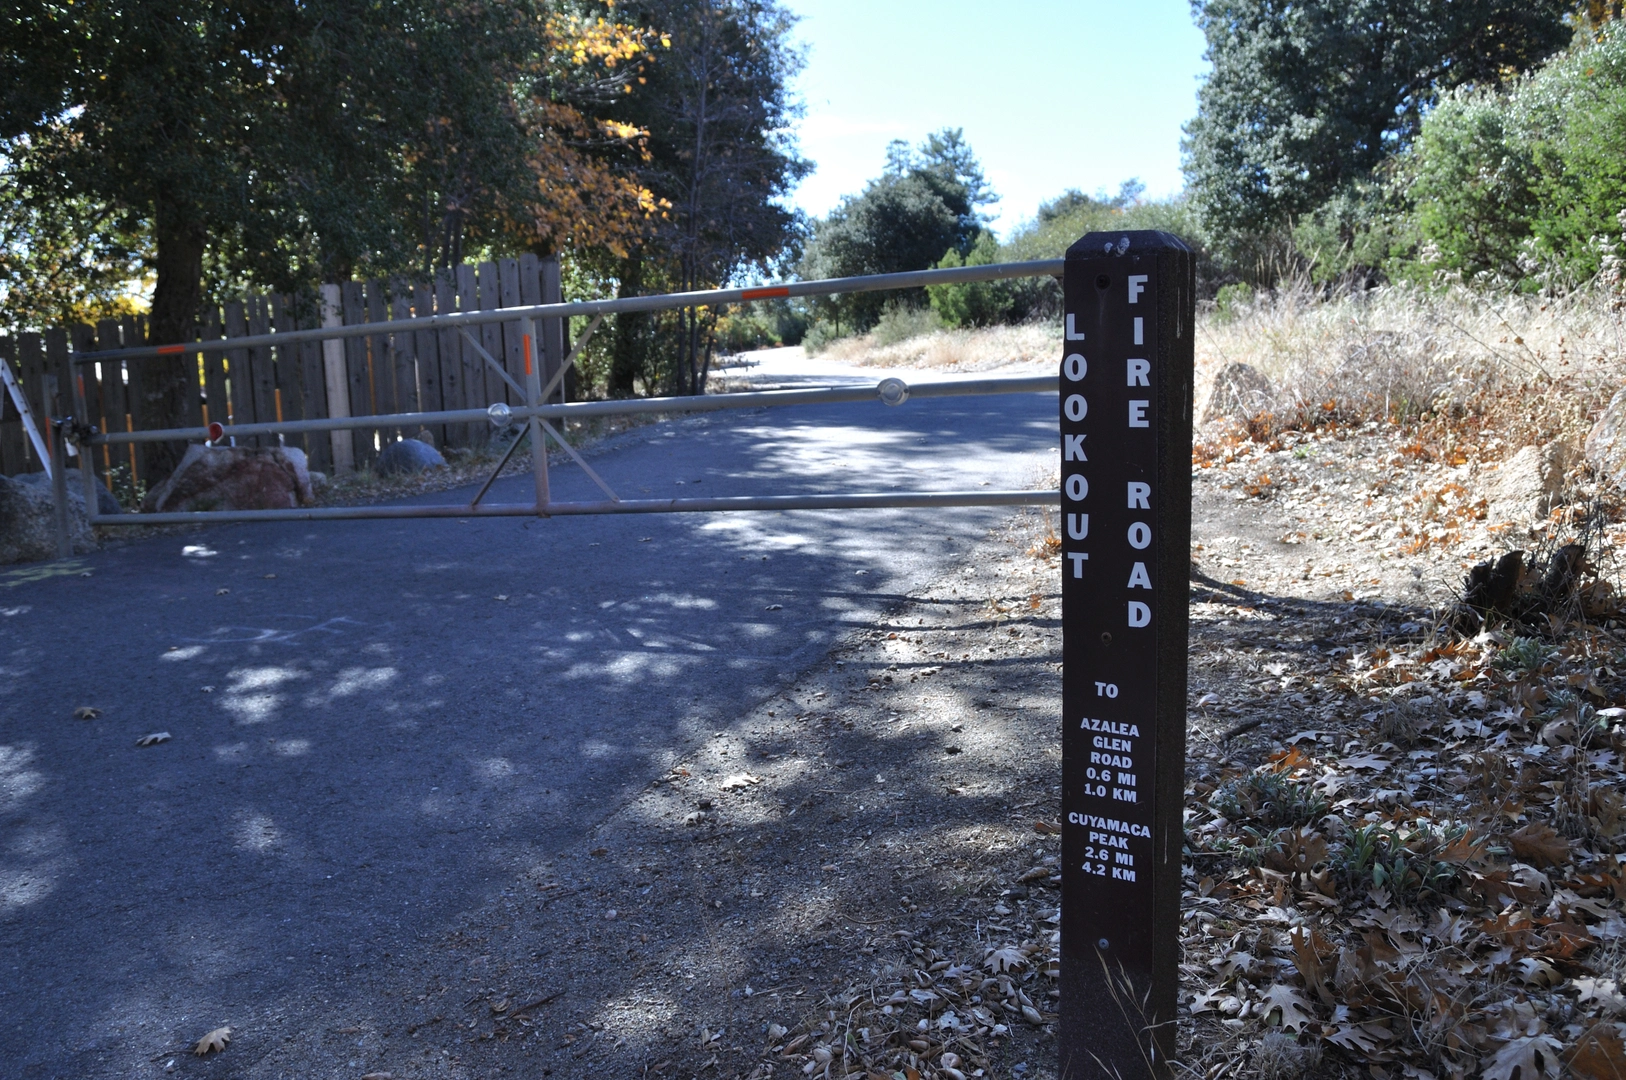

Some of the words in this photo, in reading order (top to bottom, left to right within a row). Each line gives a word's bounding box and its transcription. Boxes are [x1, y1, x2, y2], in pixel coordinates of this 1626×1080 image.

[1126, 273, 1151, 429] FIRE
[1064, 312, 1089, 580] LOOKOUT
[1126, 480, 1153, 629] ROAD
[1094, 681, 1119, 699] TO
[1080, 717, 1140, 738] AZALEA
[1092, 735, 1132, 753] GLEN
[1090, 751, 1133, 770] ROAD
[1086, 767, 1111, 783] 0.6
[1117, 772, 1137, 787] MI
[1084, 783, 1107, 798] 1.0
[1112, 787, 1137, 803] KM
[1068, 811, 1151, 839] CUYAMACA
[1089, 831, 1129, 850] PEAK
[1085, 846, 1109, 862] 2.6
[1115, 852, 1134, 867] MI
[1081, 861, 1106, 877] 4.2
[1112, 866, 1136, 883] KM
